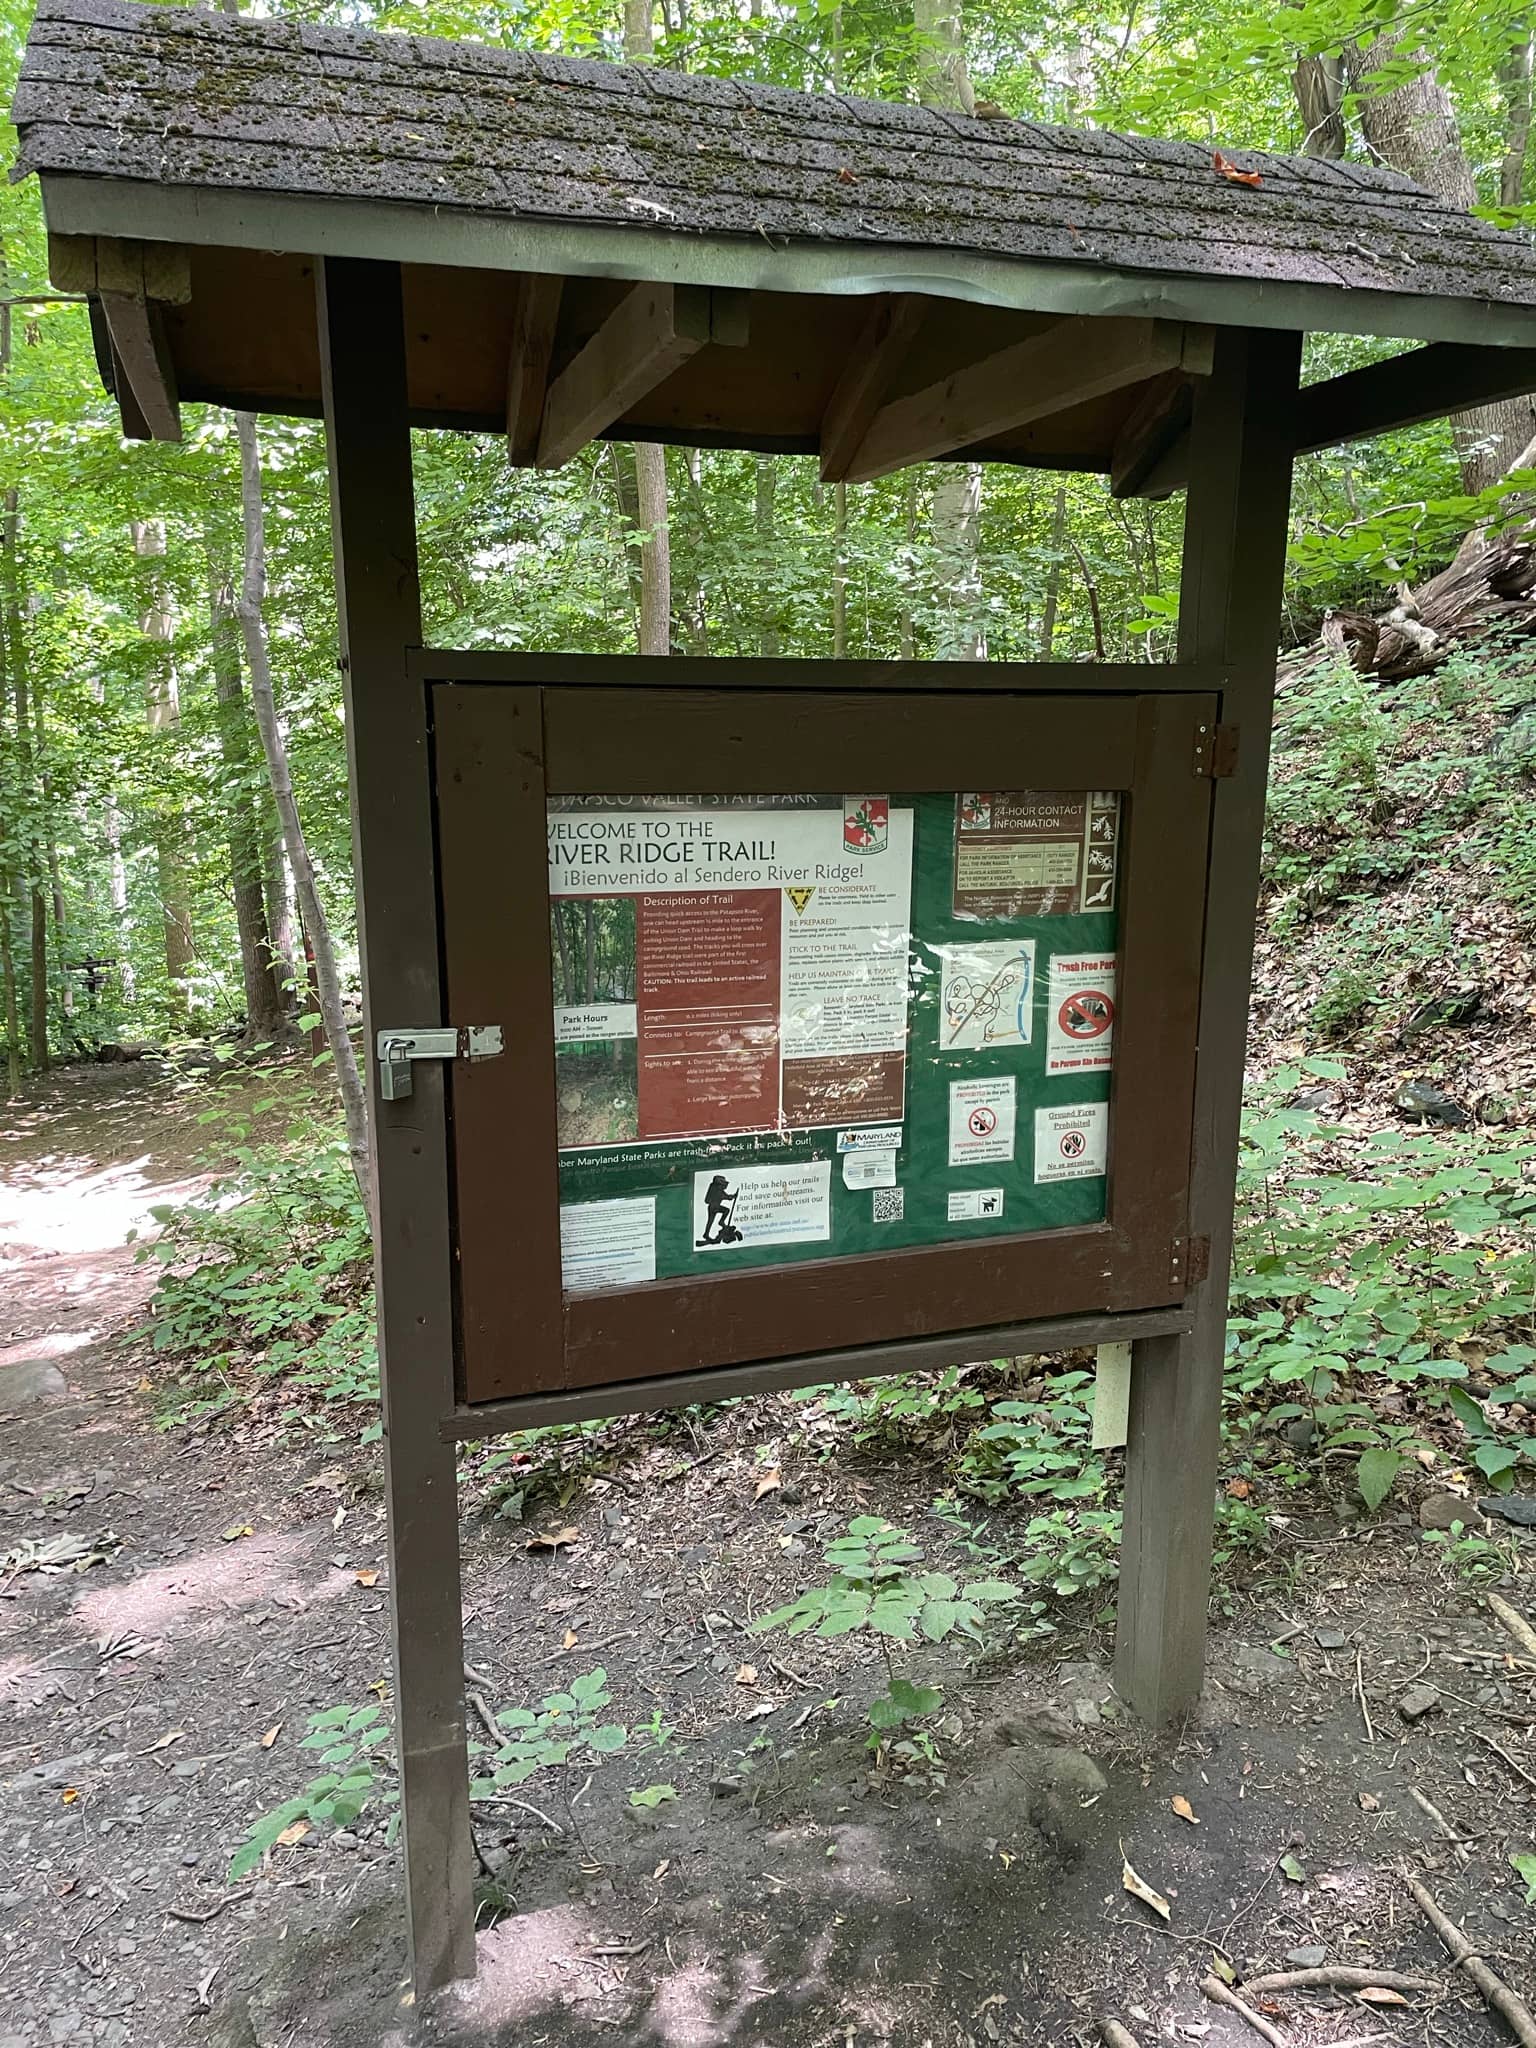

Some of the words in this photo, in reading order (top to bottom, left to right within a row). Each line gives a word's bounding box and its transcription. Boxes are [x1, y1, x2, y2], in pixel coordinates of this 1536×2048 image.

[994, 807, 1036, 816] 24-HOUR
[1038, 806, 1082, 815] CONTACT
[994, 819, 1059, 828] INFORMATION
[642, 822, 670, 838] TO
[676, 822, 714, 838] THE
[620, 842, 694, 864] RIDGE
[702, 841, 775, 862] TRAIL!
[564, 869, 668, 886] ¡Bienvenido
[674, 868, 688, 883] al
[695, 867, 761, 882] Sendero
[768, 866, 809, 881] River
[815, 864, 864, 882] Ridge!
[643, 896, 697, 907] Description
[700, 896, 710, 905] of
[712, 895, 733, 905] Trail
[1054, 1120, 1090, 1130] Prohibited
[857, 1132, 901, 1140] MARYLAND
[577, 1156, 619, 1167] Maryland
[621, 1154, 641, 1162] State
[644, 1151, 665, 1160] Parks
[740, 1183, 758, 1191] Help
[771, 1180, 786, 1189] help
[751, 1199, 793, 1210] information
[733, 1214, 749, 1222] web
